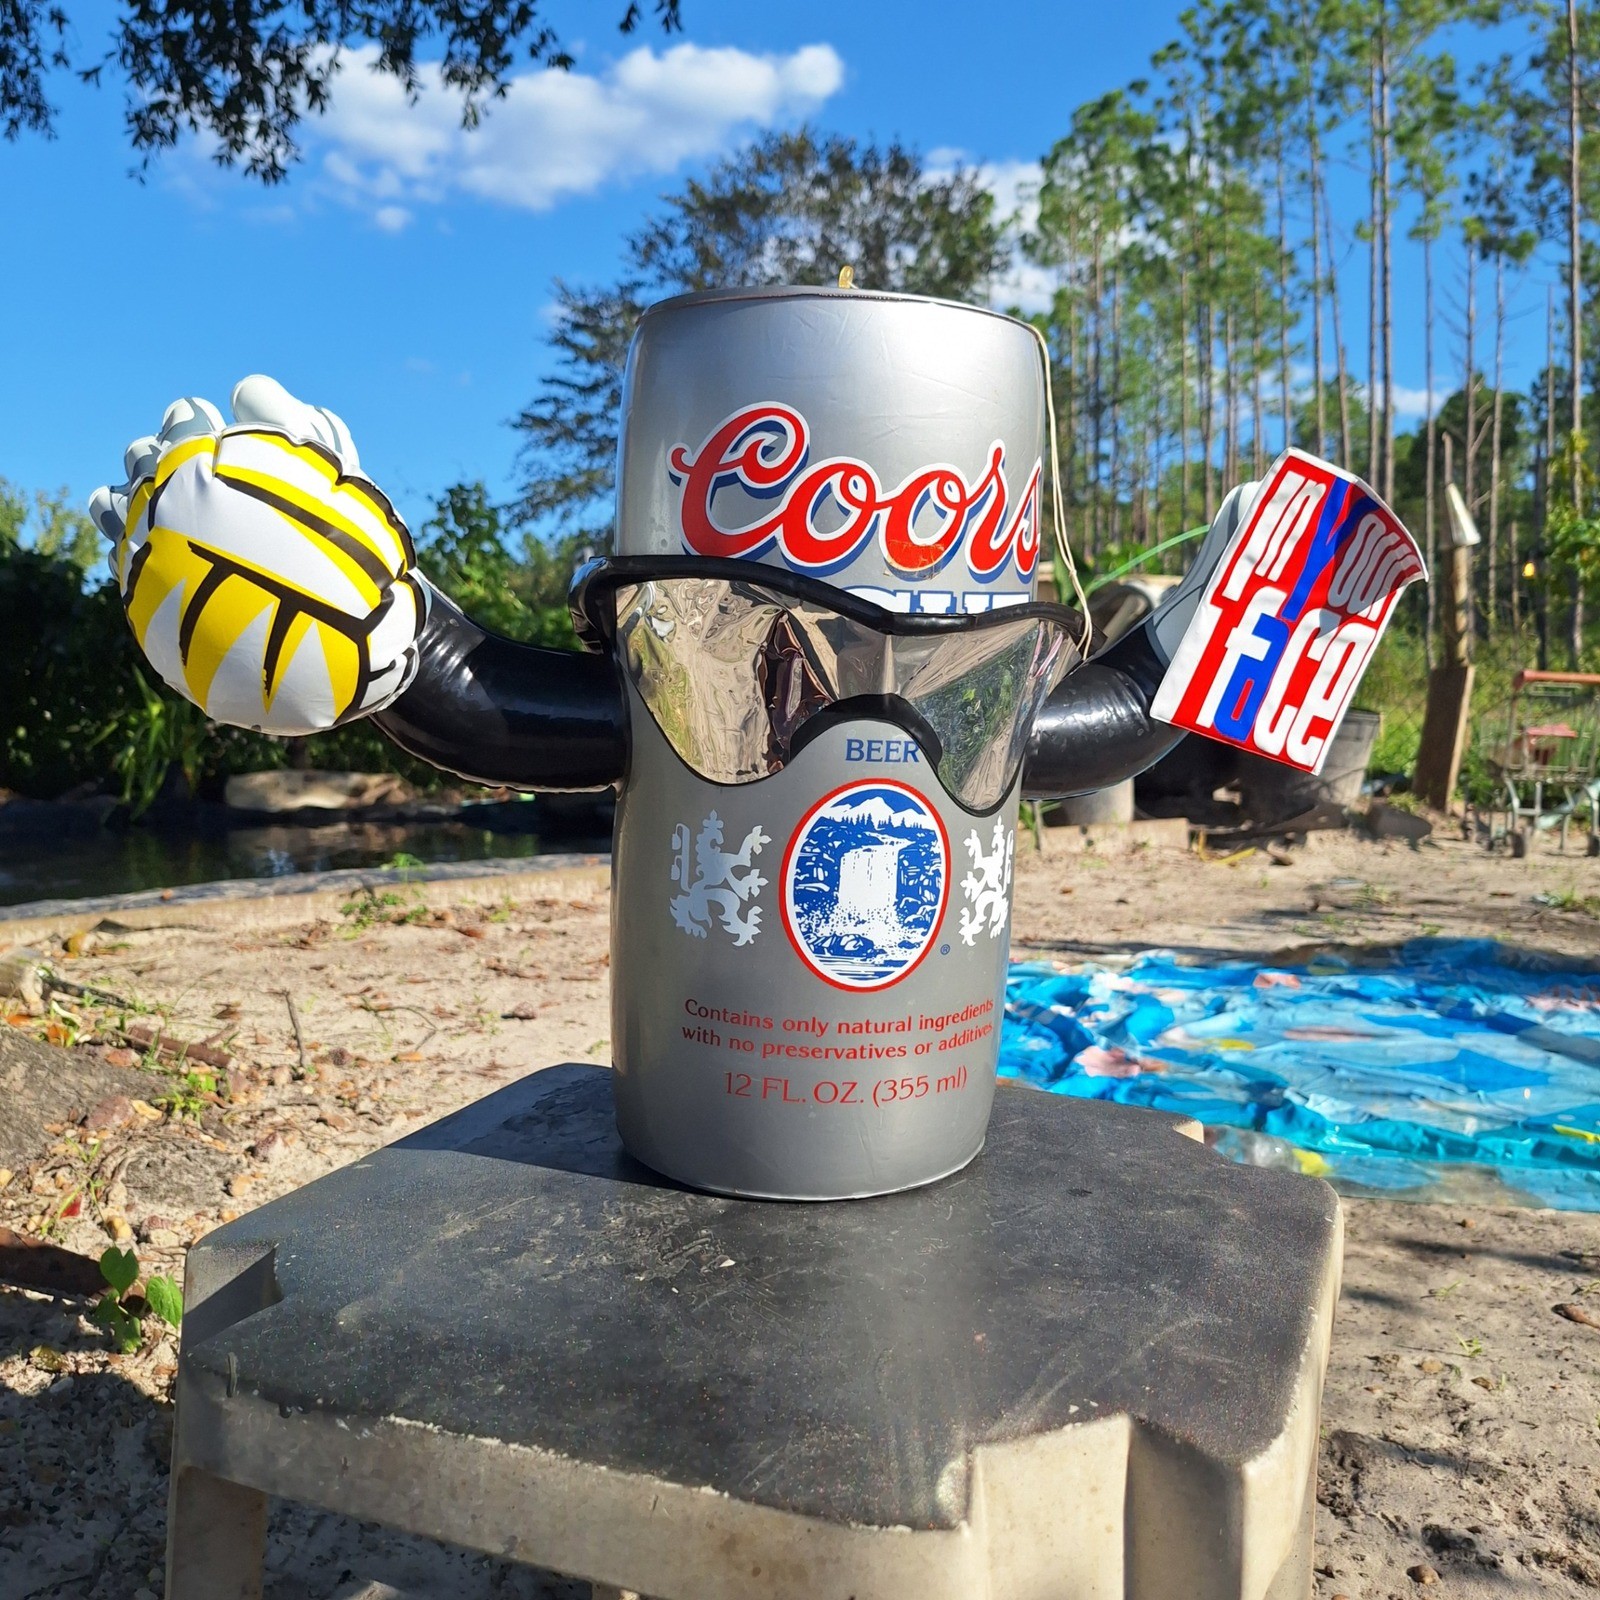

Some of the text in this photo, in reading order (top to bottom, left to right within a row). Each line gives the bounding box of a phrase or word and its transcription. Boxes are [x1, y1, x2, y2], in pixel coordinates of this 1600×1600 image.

[668, 401, 1042, 584] Coors
[1222, 470, 1327, 602] In
[1195, 586, 1378, 768] face
[845, 738, 920, 763] BEER
[684, 998, 994, 1038] Contains only natural ingredients
[681, 1022, 993, 1060] with no preservatives or additives
[724, 1064, 968, 1108] 12 FL. OZ. (355 ml)
